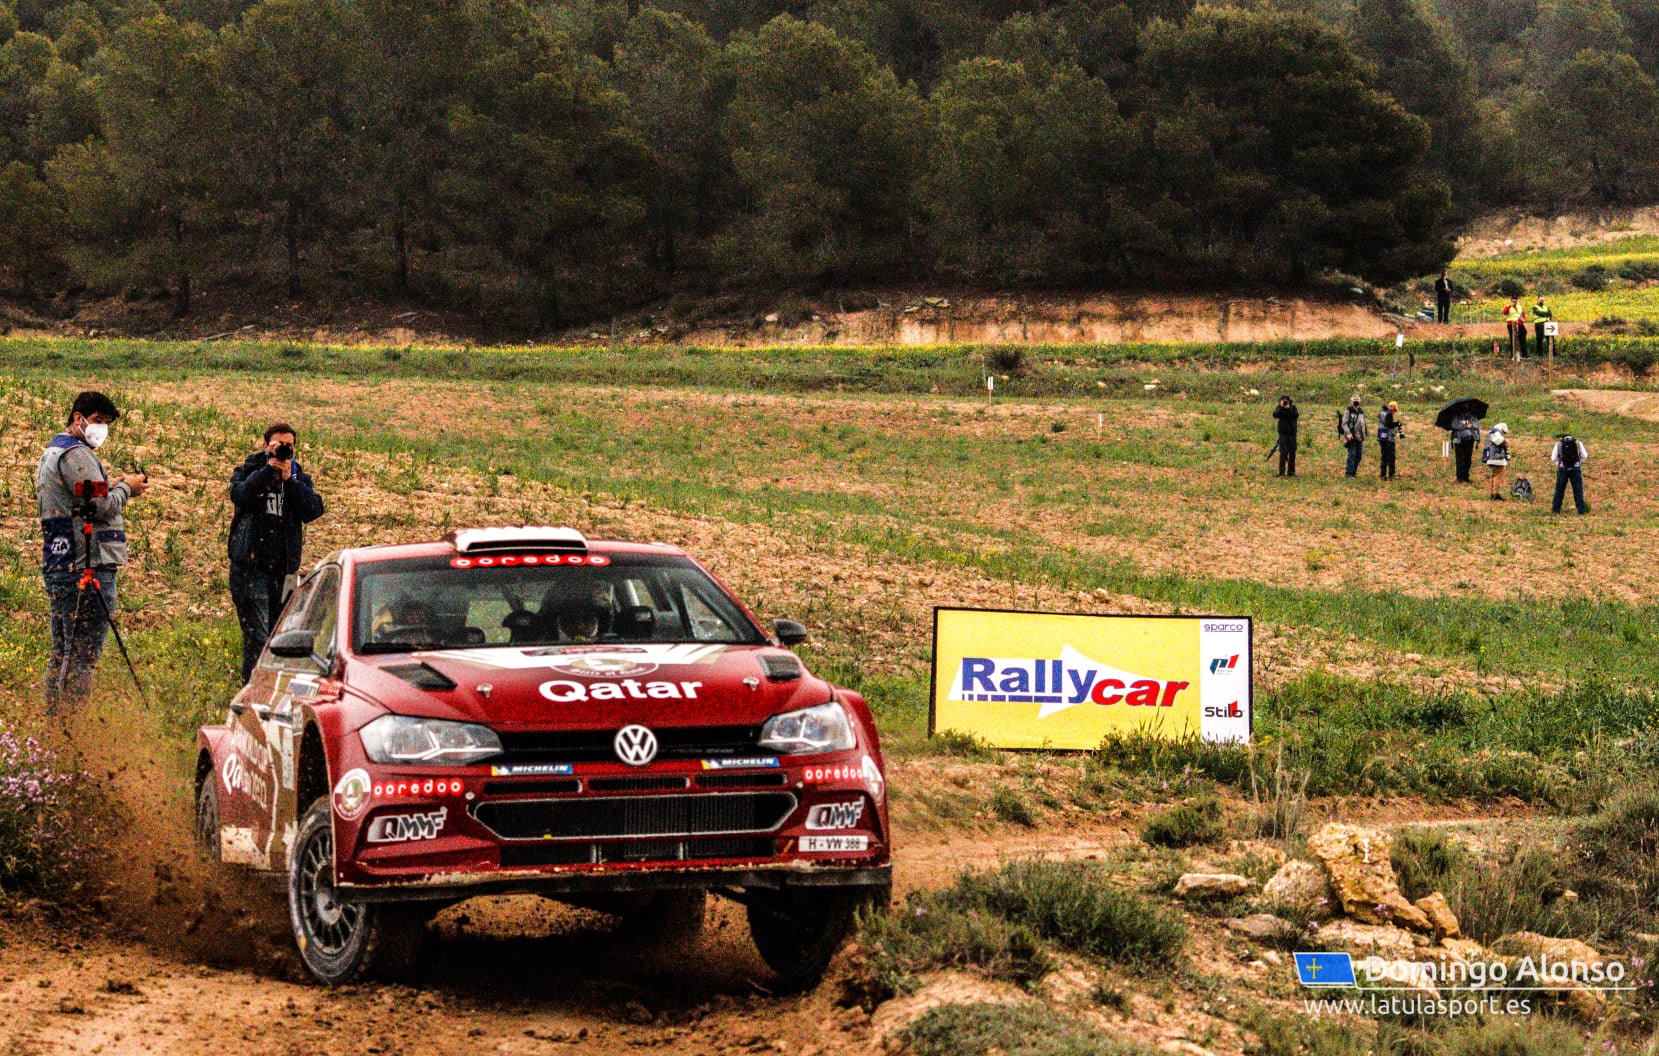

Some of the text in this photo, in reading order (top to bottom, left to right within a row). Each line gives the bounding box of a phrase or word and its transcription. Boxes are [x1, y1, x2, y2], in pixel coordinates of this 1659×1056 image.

[456, 555, 605, 566] ooredoo
[1204, 623, 1243, 632] sparco
[539, 679, 703, 703] Qatar
[1205, 702, 1243, 718] Stilo
[722, 758, 775, 766] MICHELIN
[512, 765, 569, 773] MICHELIN
[805, 766, 863, 780] ooredoo
[374, 780, 461, 796] ooredoo
